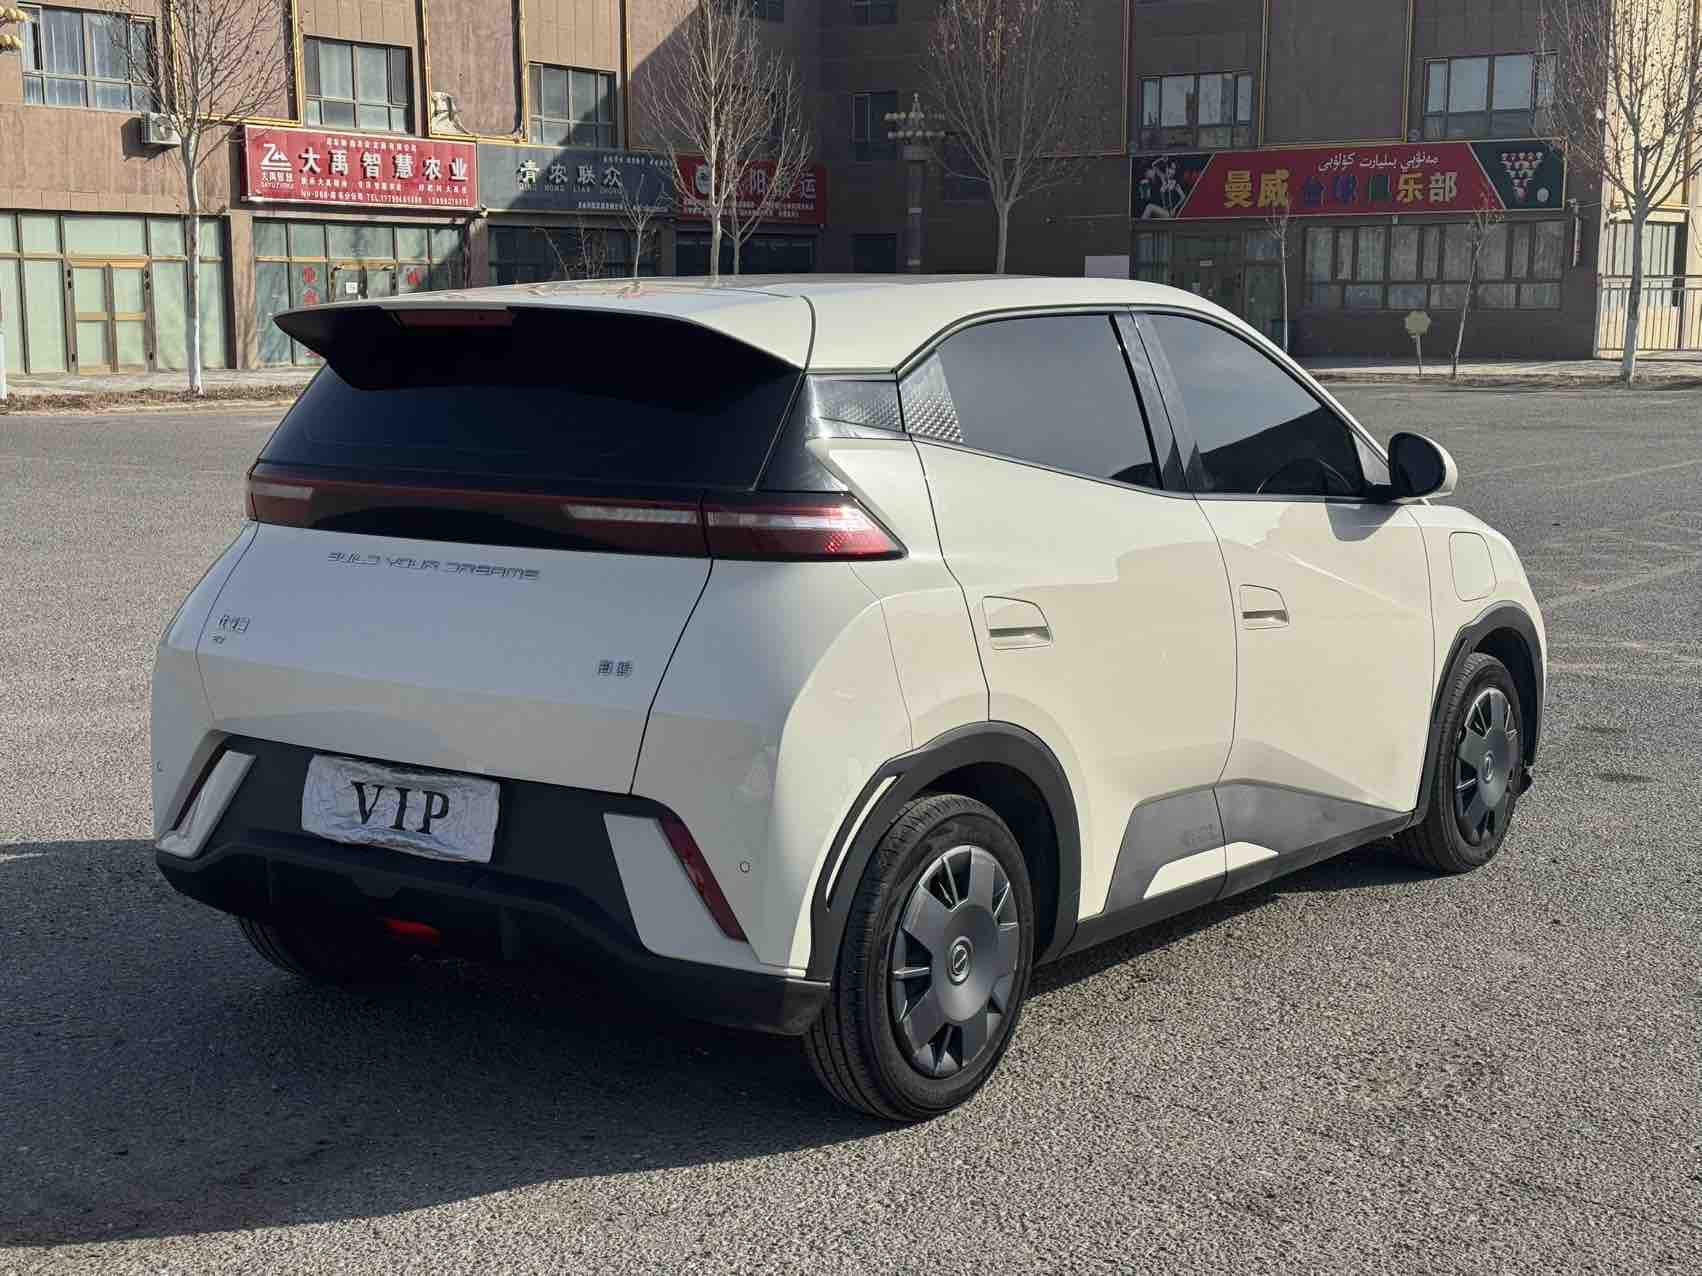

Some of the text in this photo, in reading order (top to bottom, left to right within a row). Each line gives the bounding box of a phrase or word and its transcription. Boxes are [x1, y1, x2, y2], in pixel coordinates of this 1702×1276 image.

[300, 147, 468, 181] 大禹智慧农业
[386, 554, 441, 570] YOUR
[443, 561, 540, 579] DREAMS
[351, 781, 450, 834] VIP
